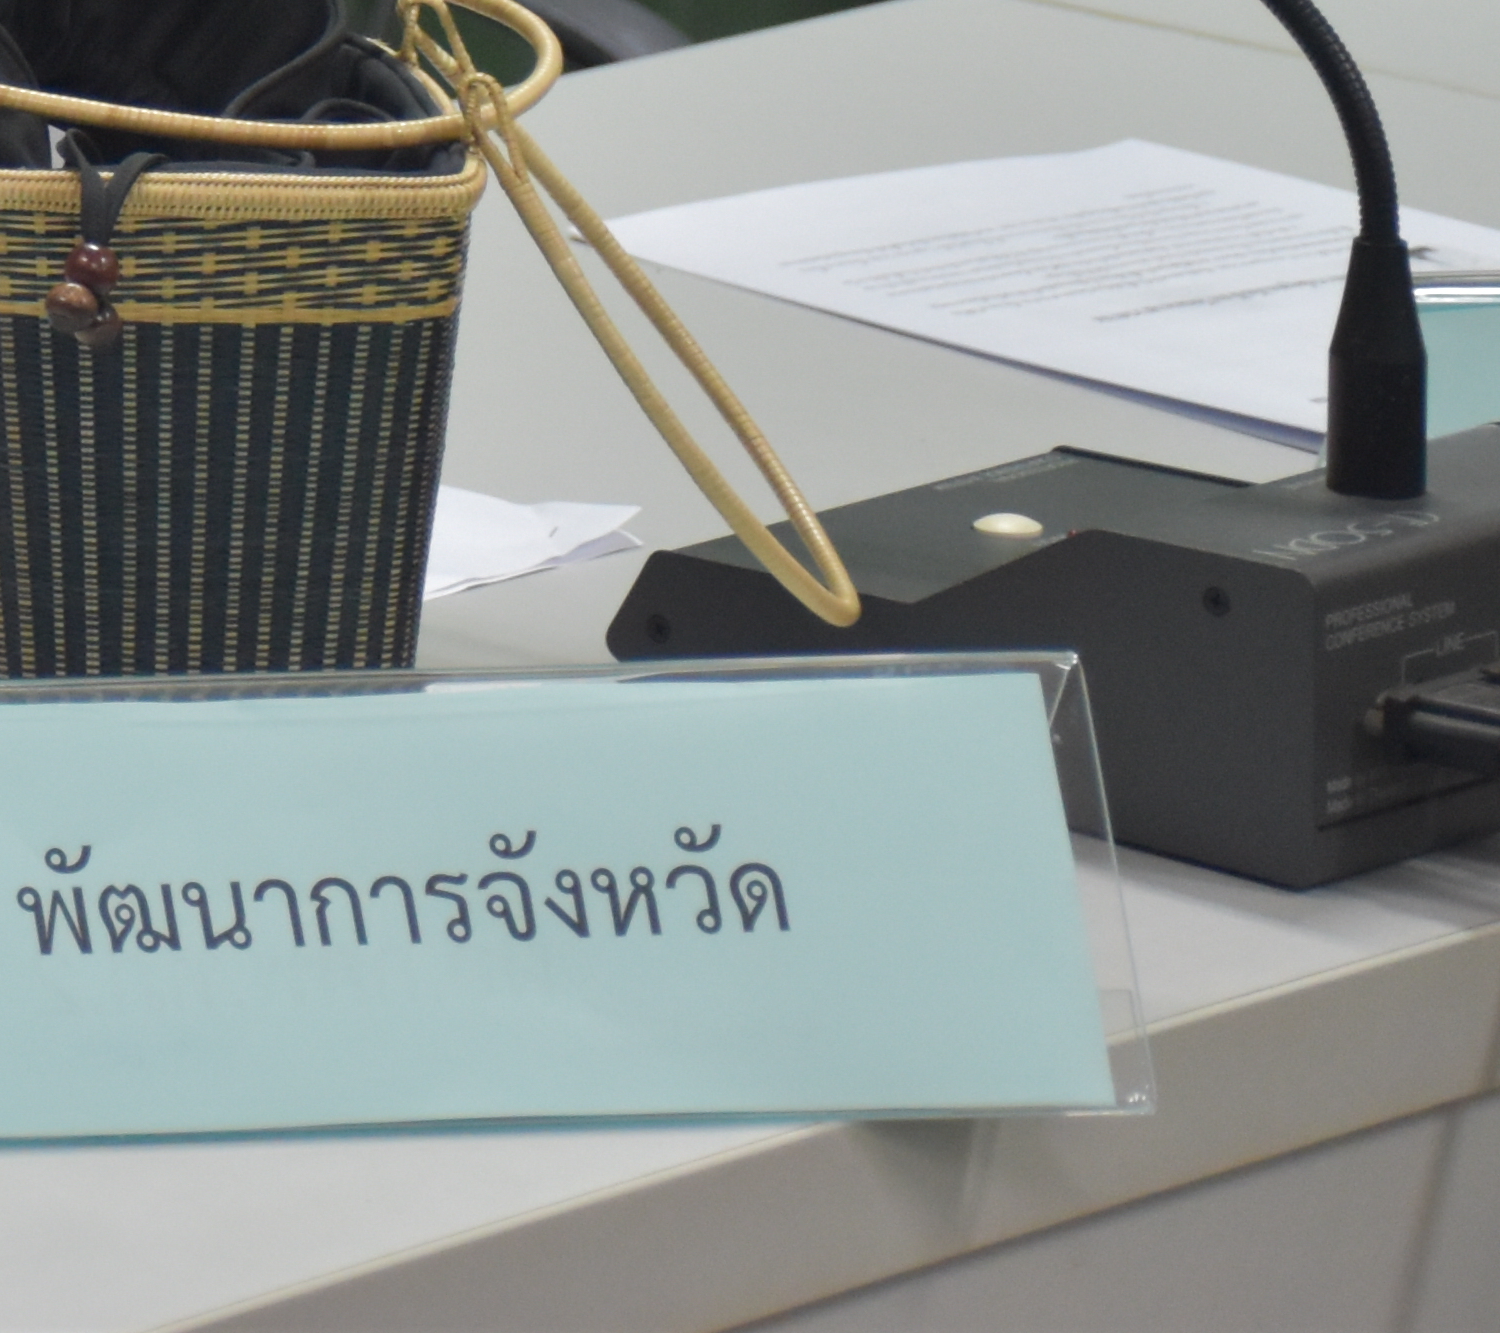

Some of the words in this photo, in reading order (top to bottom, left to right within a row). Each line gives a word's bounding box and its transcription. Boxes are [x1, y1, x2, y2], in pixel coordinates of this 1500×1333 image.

[16, 823, 791, 955] พัฒนาการจังหวัด
